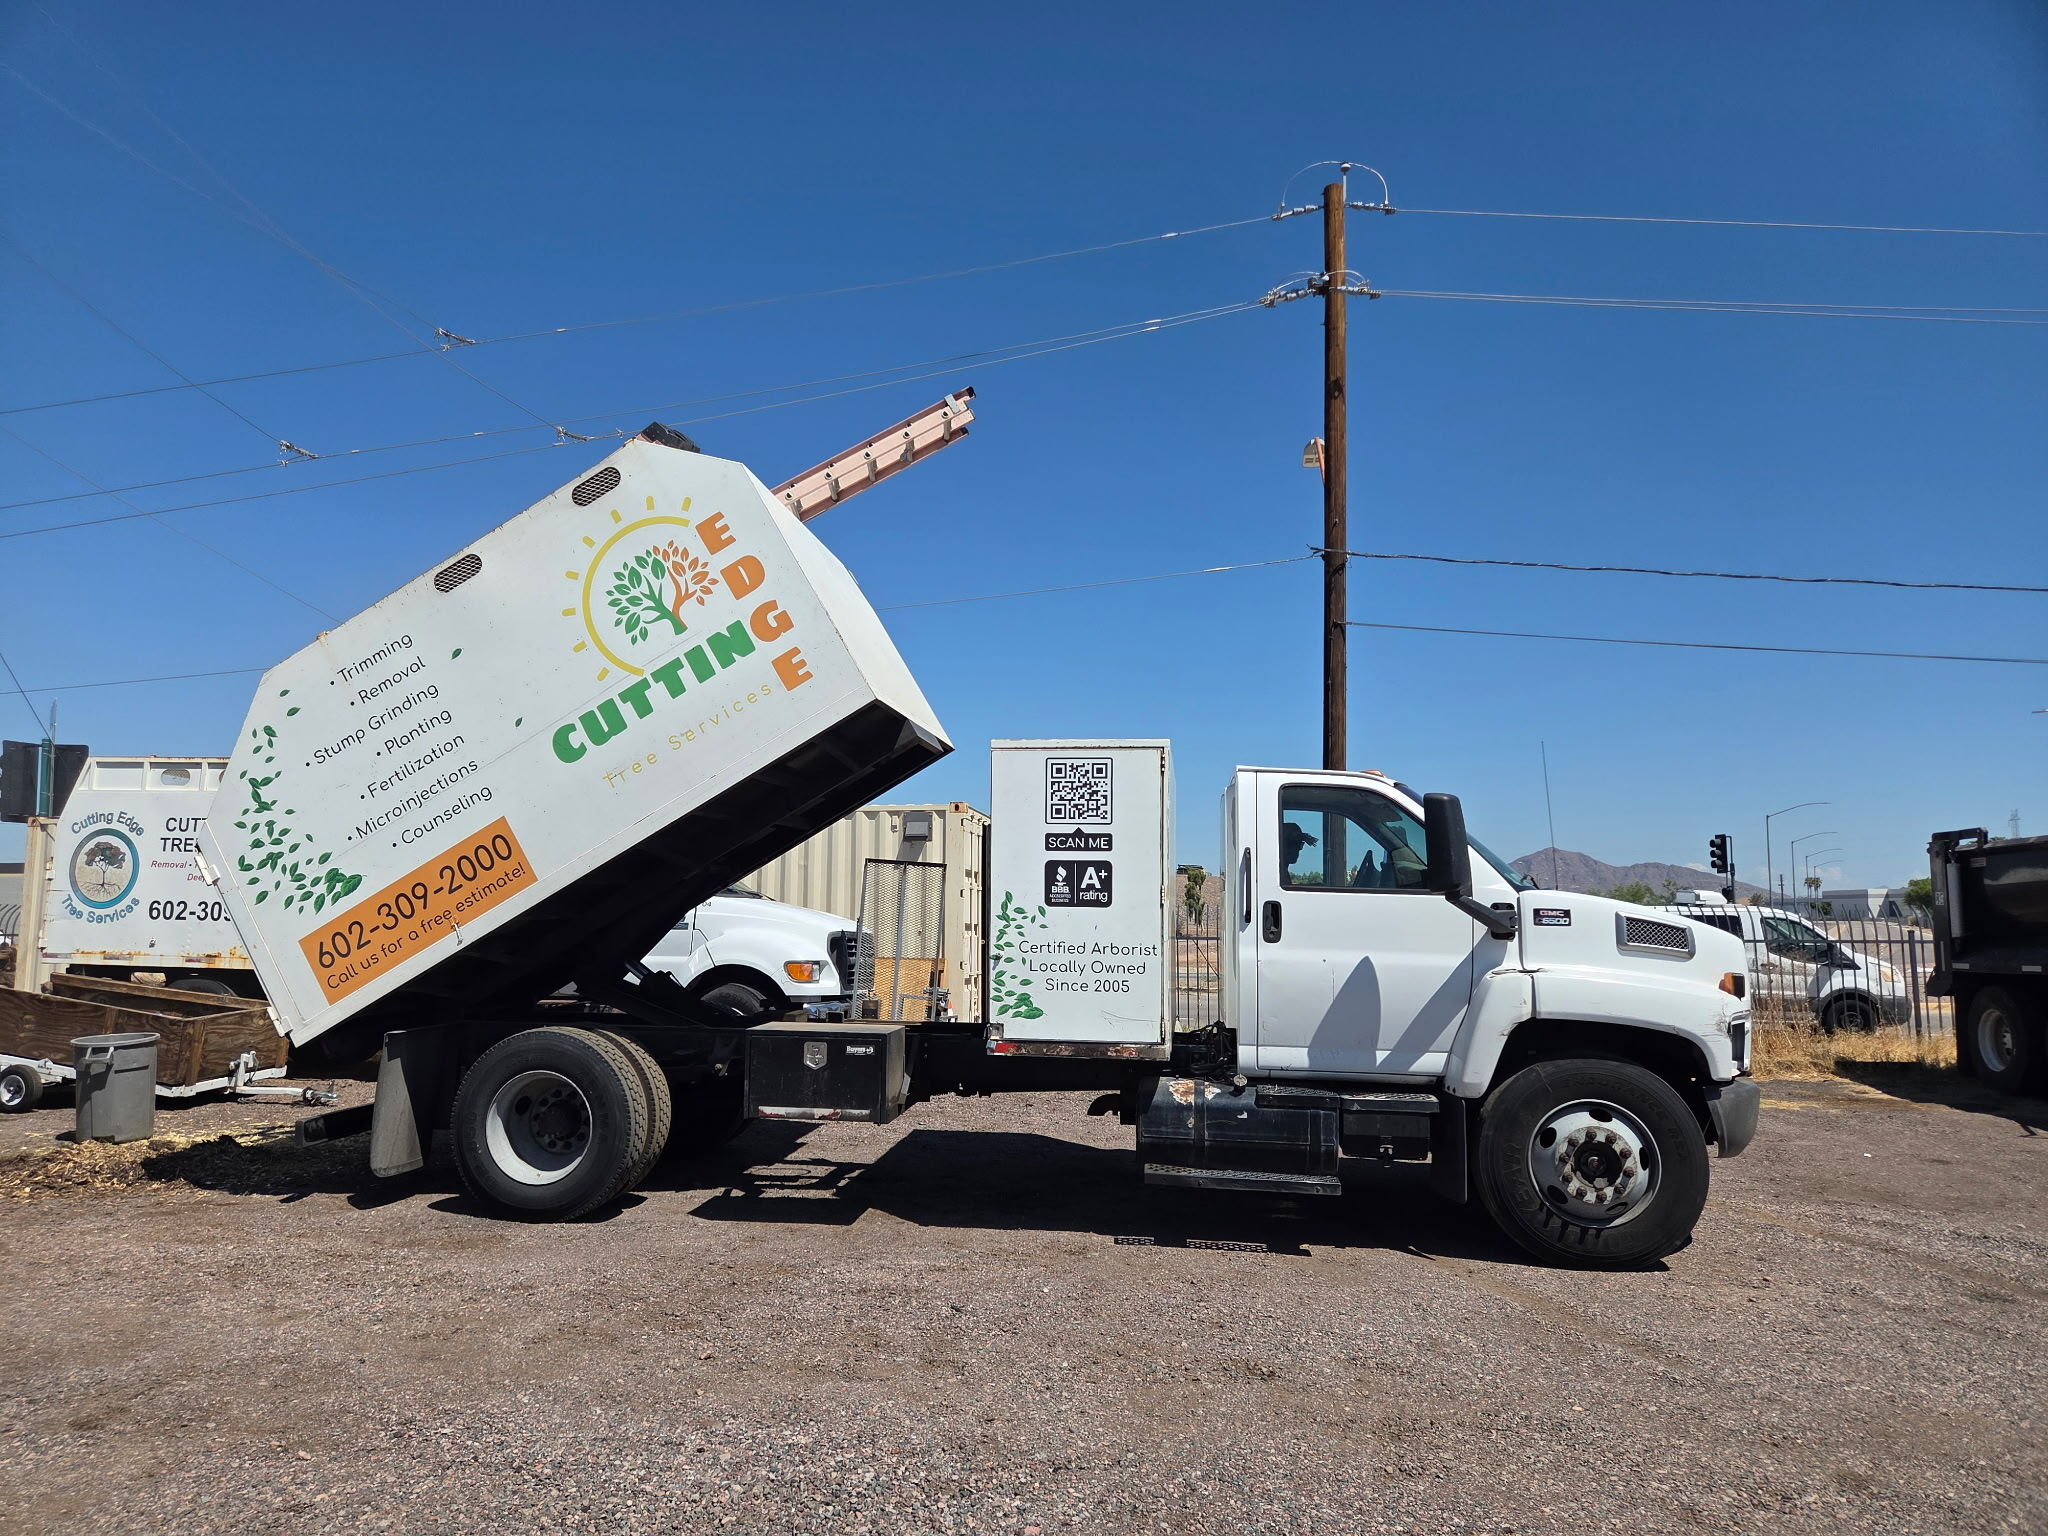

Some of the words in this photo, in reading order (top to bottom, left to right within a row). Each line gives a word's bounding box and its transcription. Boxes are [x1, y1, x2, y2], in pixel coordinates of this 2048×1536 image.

[695, 511, 813, 692] EDGE
[337, 632, 414, 682] Trimming
[357, 656, 426, 704] Removal
[313, 727, 366, 765] Stump
[368, 682, 440, 731] Grinding
[384, 708, 453, 755] Planting
[602, 752, 658, 788] Tree
[668, 683, 771, 751] Services
[367, 733, 466, 799] Fertilization
[355, 758, 479, 840] Microinjections
[400, 785, 493, 846] Counseling
[71, 812, 114, 834] Cutting
[116, 811, 145, 836] Edge
[160, 837, 198, 852] TRE
[1048, 837, 1085, 848] SCAN
[1089, 837, 1110, 848] ME
[150, 860, 187, 868] Removal
[1080, 866, 1108, 889] A+
[61, 893, 83, 920] Tree
[86, 897, 140, 924] Services
[316, 833, 513, 969] 602-309-2000
[1079, 890, 1108, 903] rating
[327, 965, 359, 990] Call
[361, 952, 380, 970] us
[381, 935, 403, 958] for
[408, 929, 420, 942] a
[420, 907, 452, 937] free
[454, 862, 526, 914] estimate!
[1018, 940, 1086, 955] Certified
[1091, 942, 1158, 957] Arborist
[1029, 959, 1086, 977] Locally
[1091, 960, 1146, 976] Owned
[1045, 978, 1089, 992] Since
[1094, 979, 1130, 993] 2005
